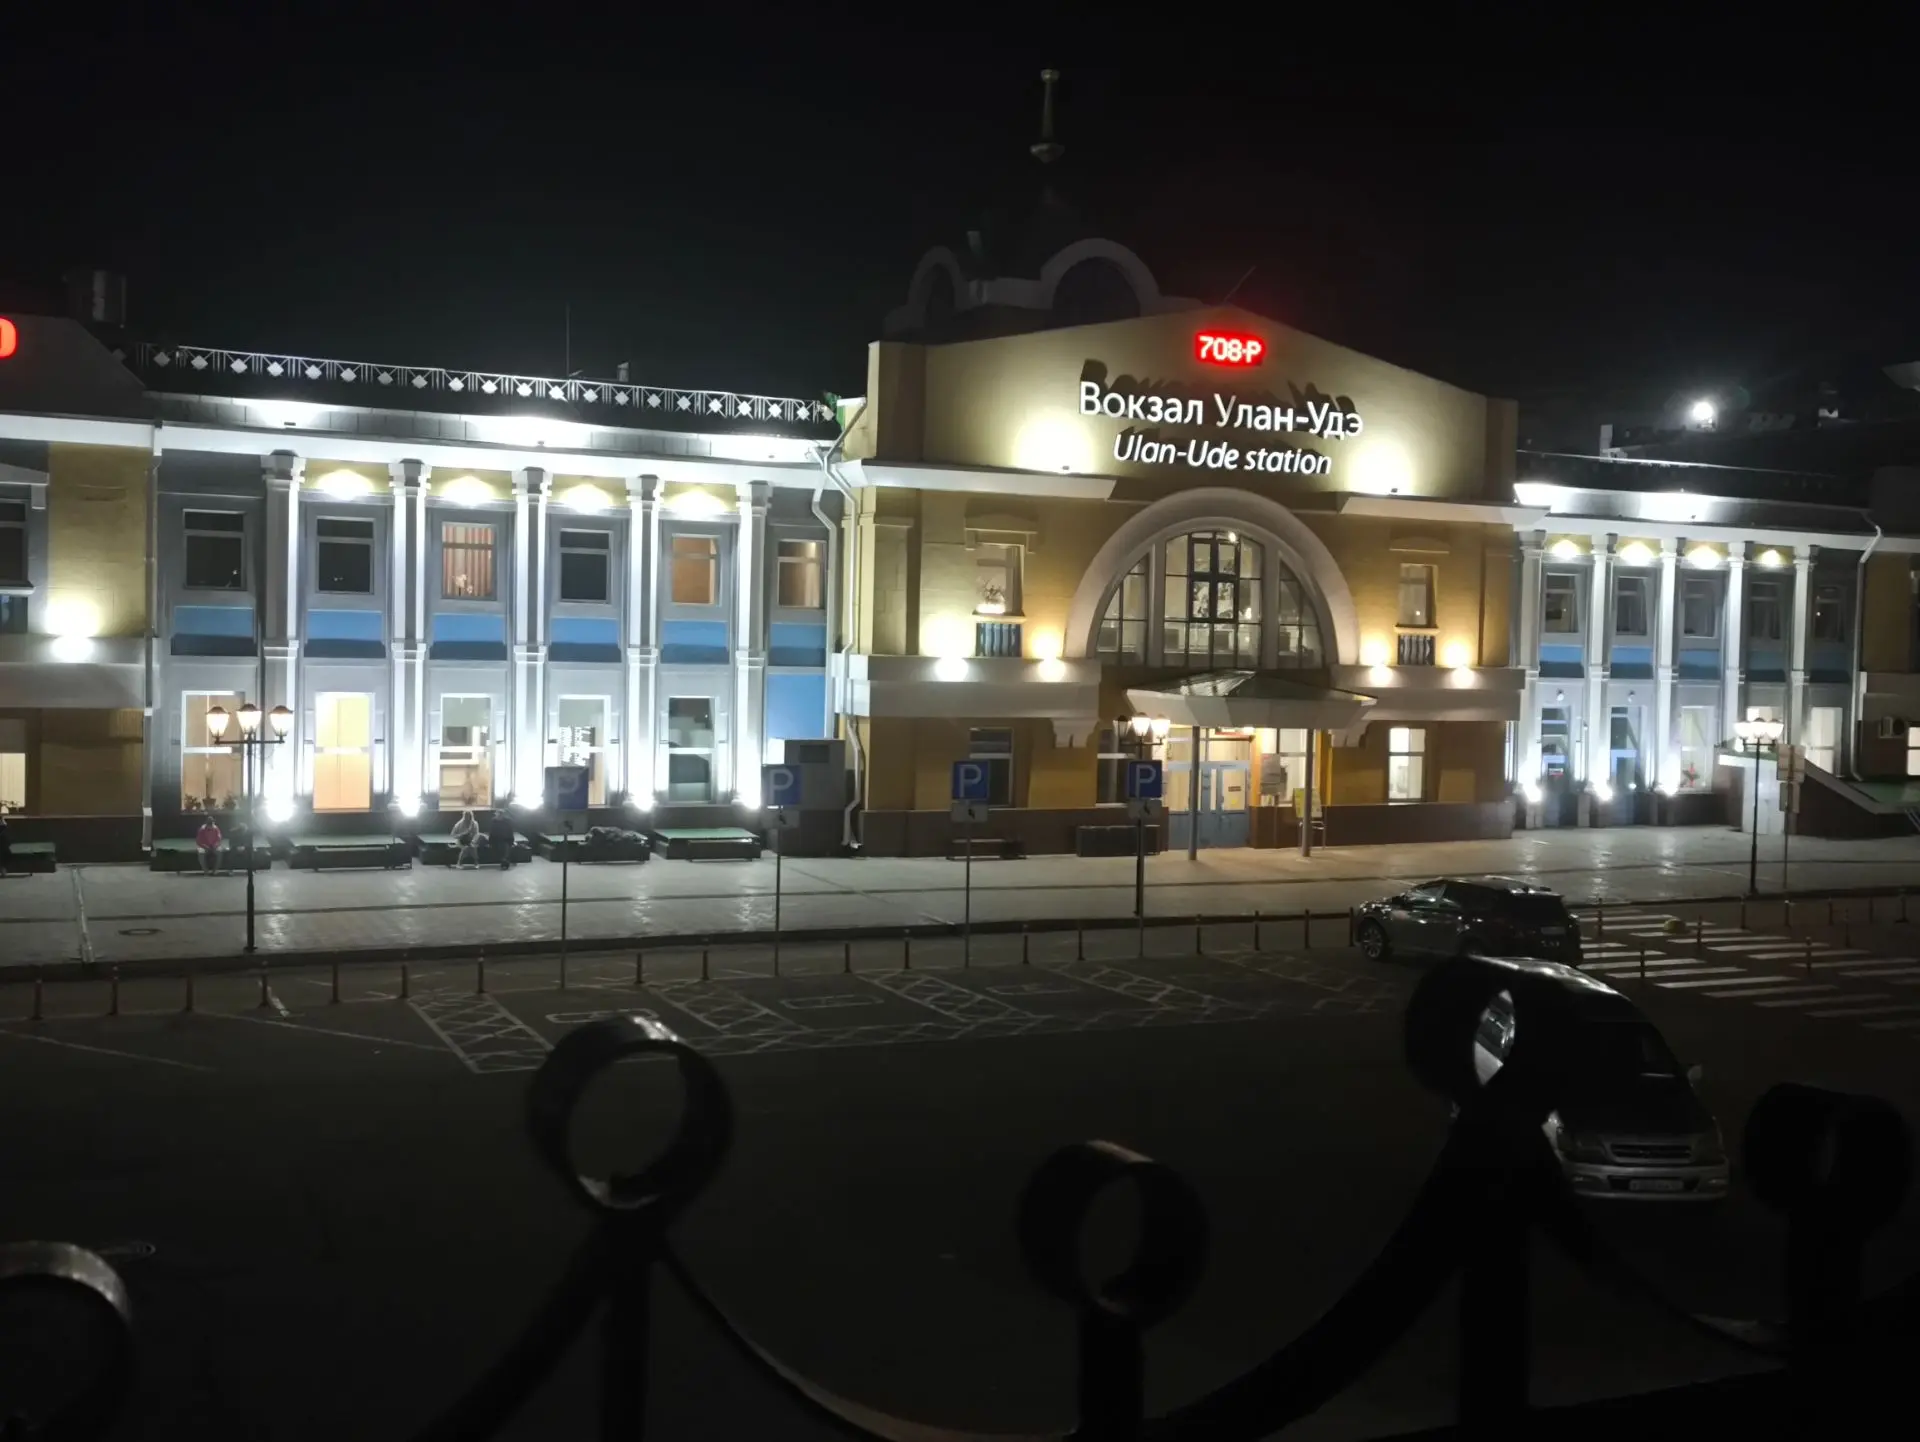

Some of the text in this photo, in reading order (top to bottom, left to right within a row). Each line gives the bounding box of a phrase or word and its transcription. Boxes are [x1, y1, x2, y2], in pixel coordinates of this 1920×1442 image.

[1079, 381, 1364, 441] Вокзал Улан-Удэ
[1113, 433, 1332, 475] Ulan-Ude station
[556, 772, 580, 806] P
[768, 768, 794, 806] P
[959, 763, 982, 798] P
[1135, 763, 1157, 797] P
